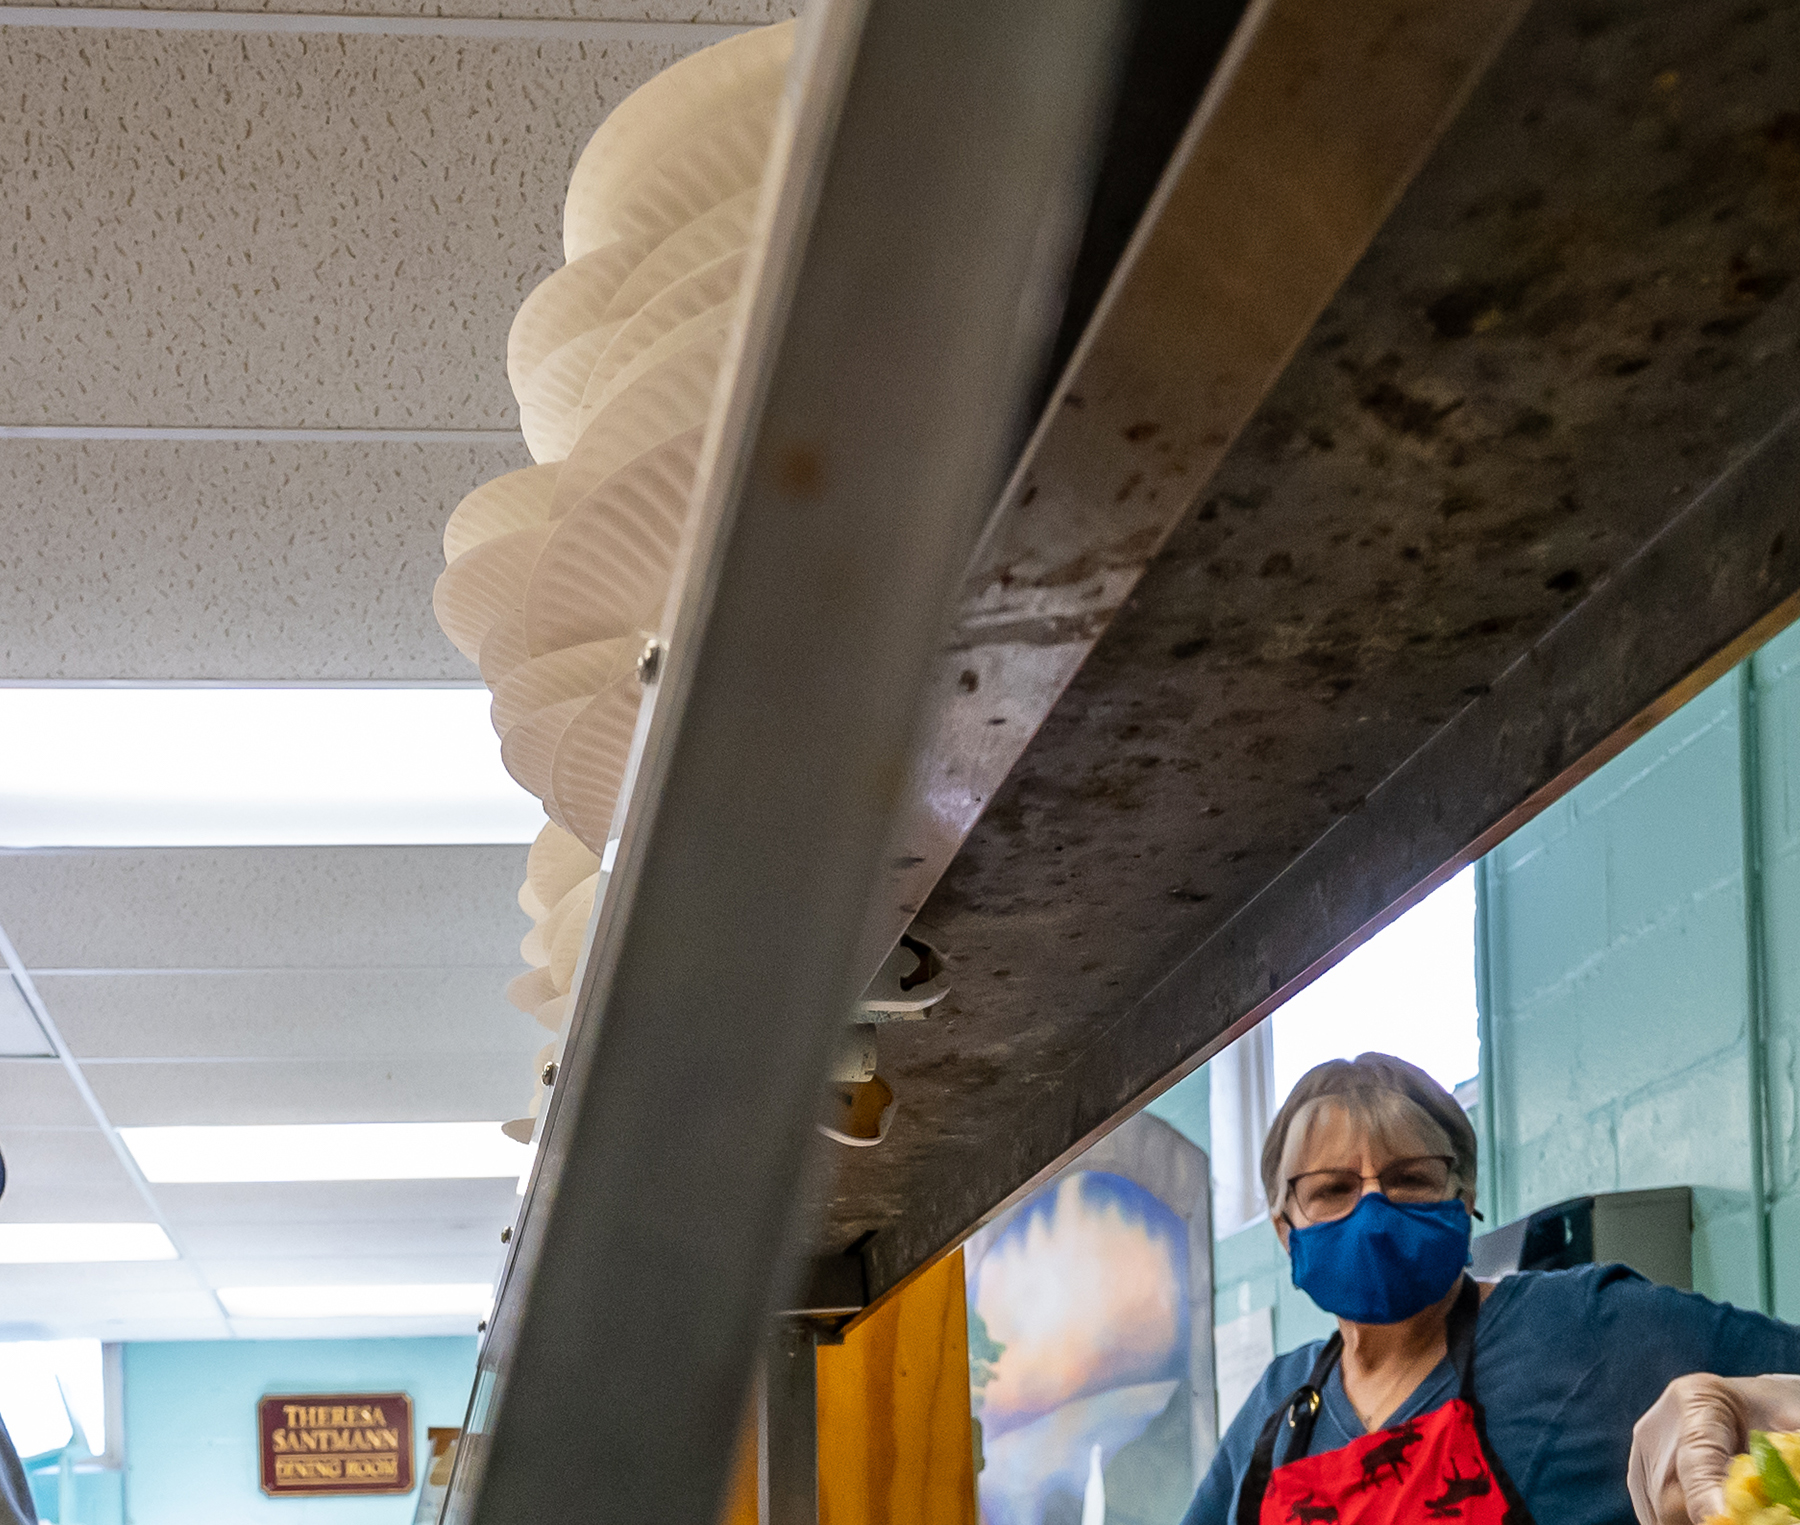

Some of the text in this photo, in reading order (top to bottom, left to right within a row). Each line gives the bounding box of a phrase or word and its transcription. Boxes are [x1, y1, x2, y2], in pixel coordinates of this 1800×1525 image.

[283, 1404, 386, 1428] THERESA
[272, 1428, 398, 1453] SANTMANN
[276, 1458, 398, 1479] DINING ROOM
